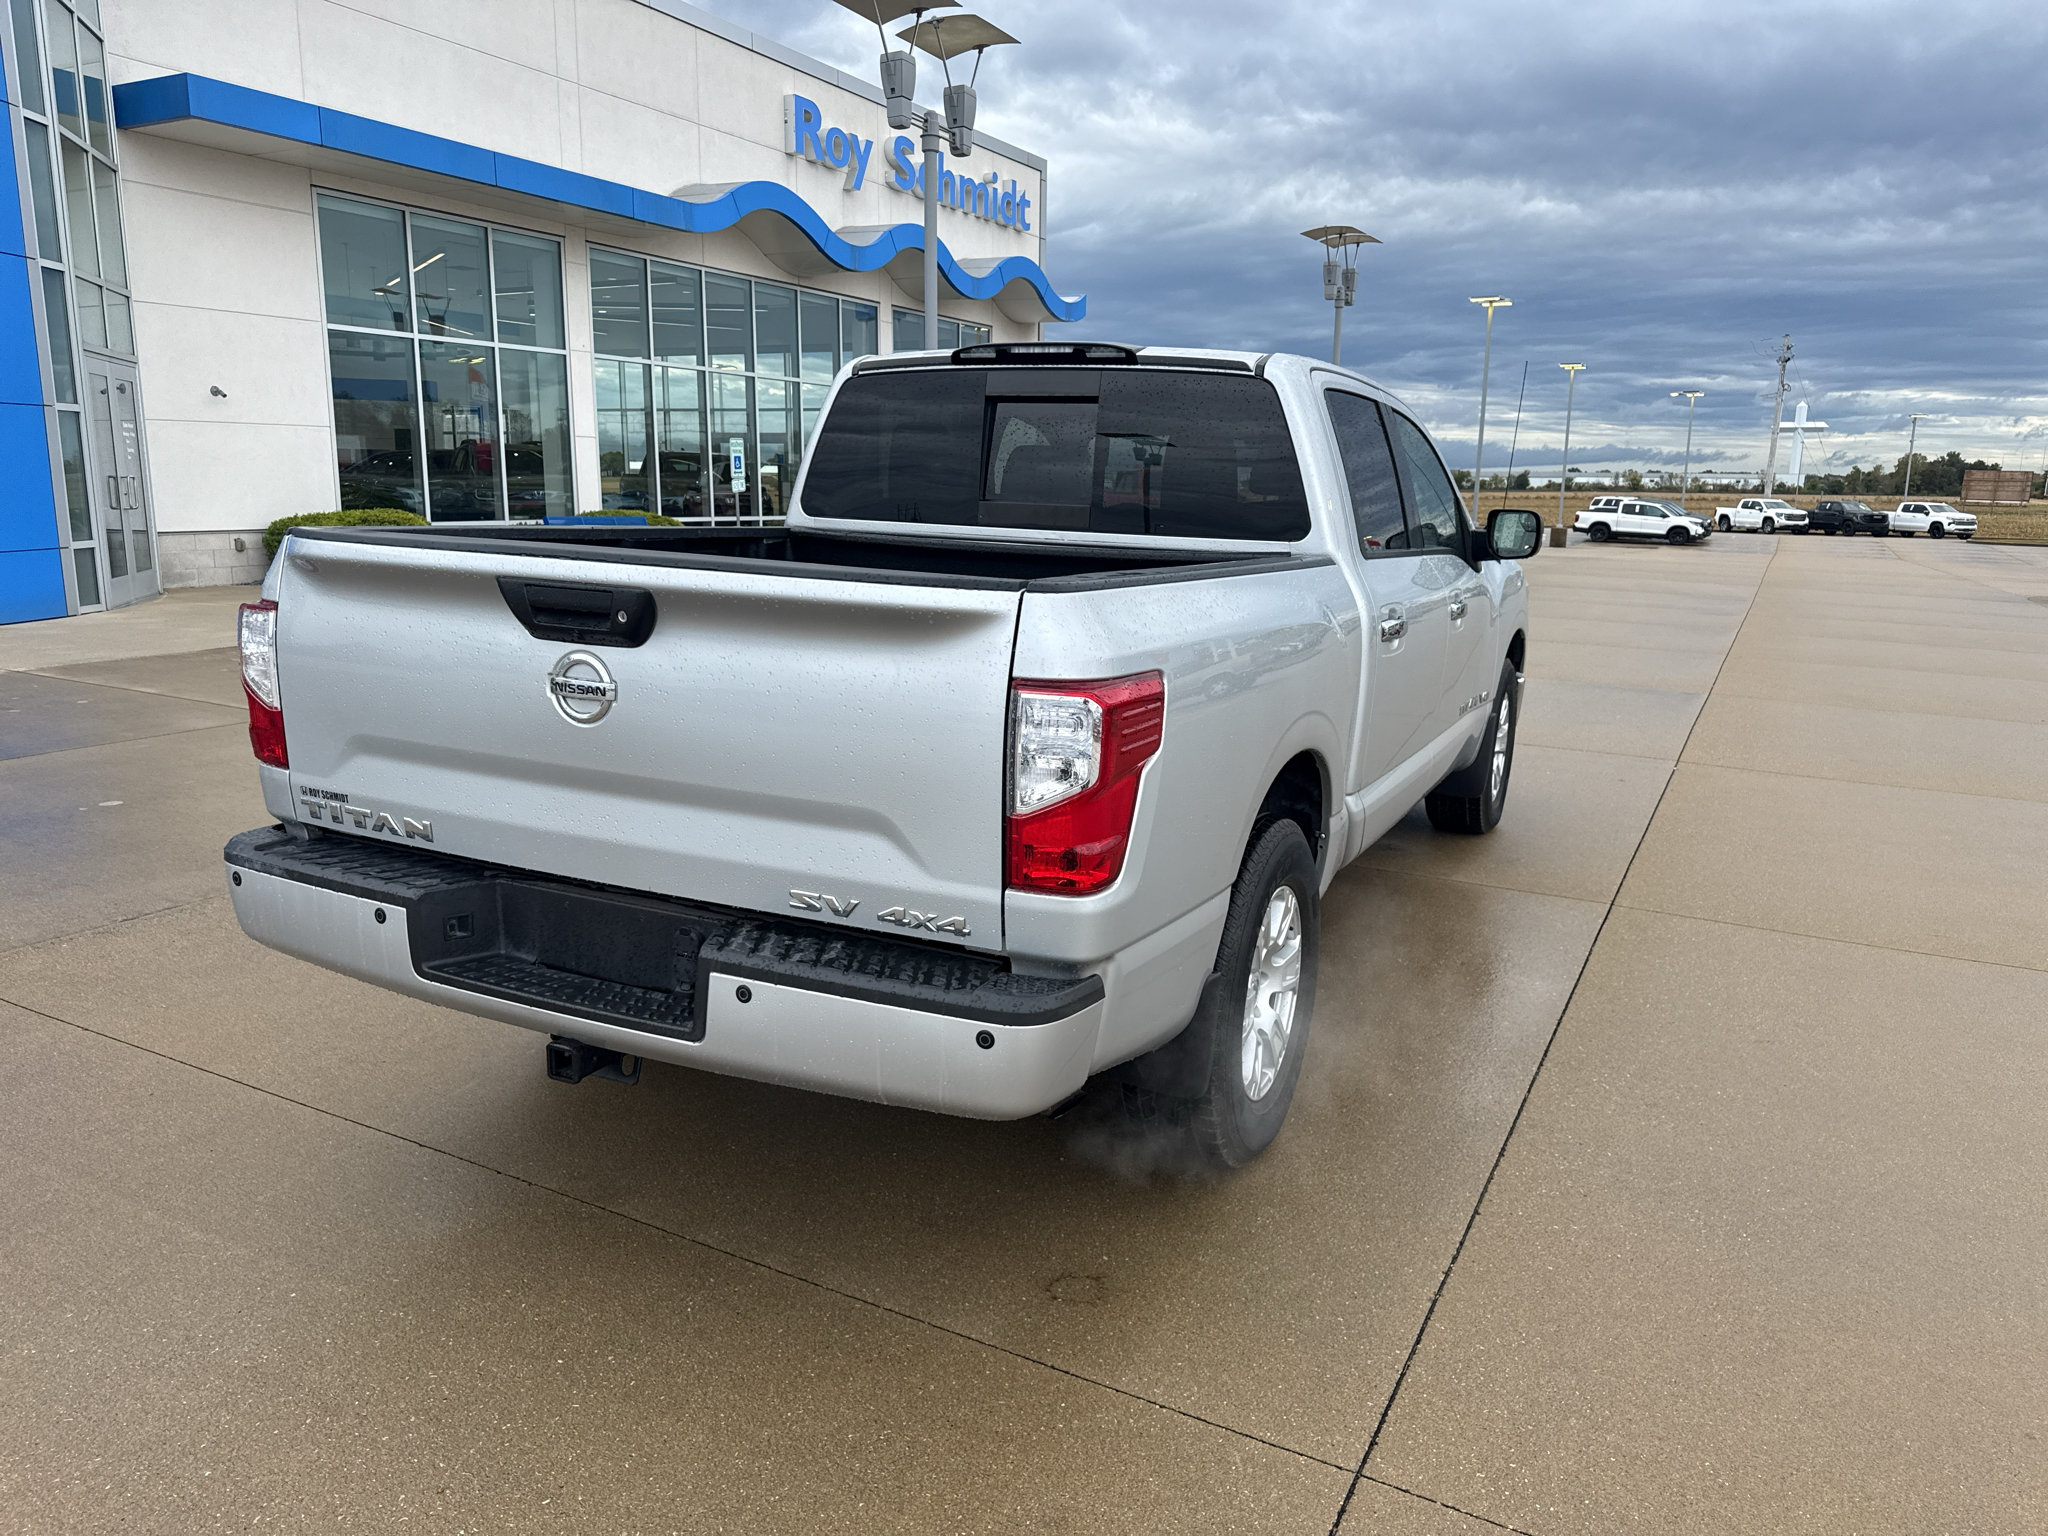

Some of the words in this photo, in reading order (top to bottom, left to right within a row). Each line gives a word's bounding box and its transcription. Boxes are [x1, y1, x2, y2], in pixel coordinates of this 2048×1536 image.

[785, 94, 873, 191] Roy
[555, 681, 607, 697] NISSAN
[308, 788, 320, 798] ROY
[321, 790, 349, 803] SCHMIDT
[301, 797, 434, 843] TITAN
[789, 889, 860, 918] SV
